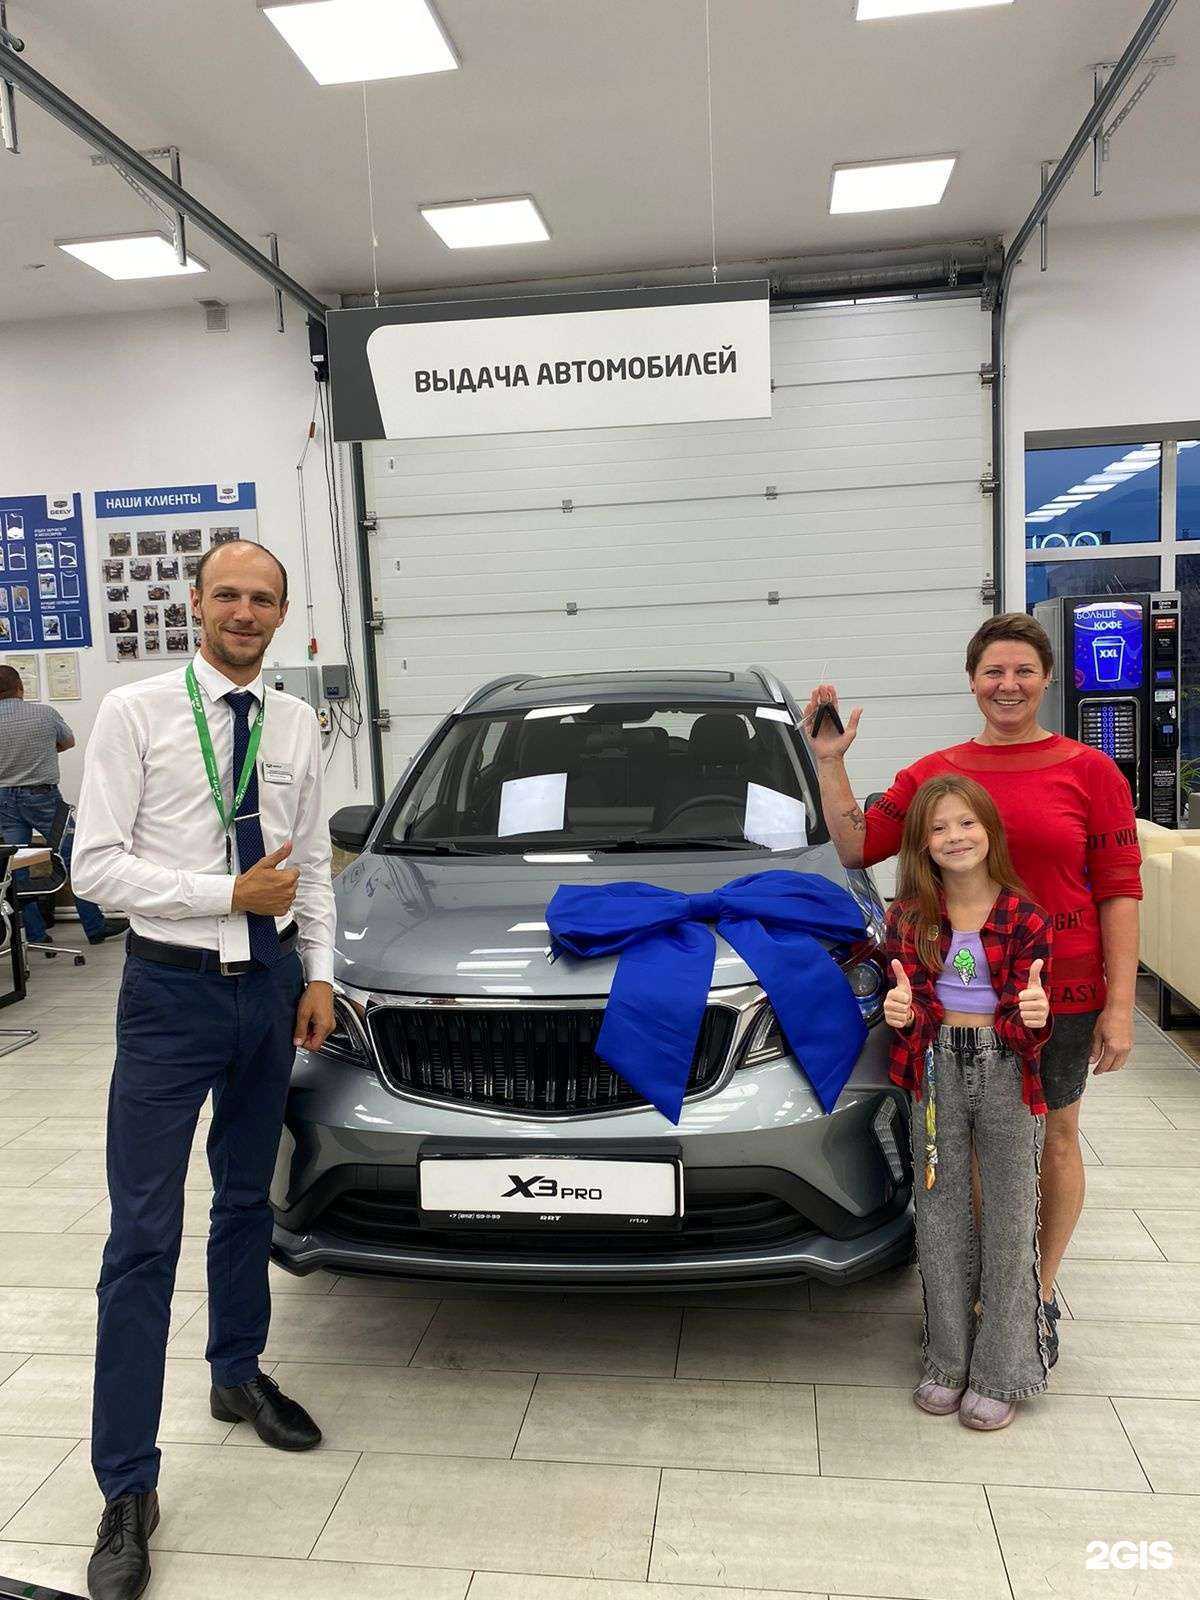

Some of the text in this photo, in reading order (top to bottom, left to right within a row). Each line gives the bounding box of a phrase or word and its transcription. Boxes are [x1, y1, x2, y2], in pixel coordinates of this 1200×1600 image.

[414, 344, 738, 394] ВЫДАЧА АВТОМОБИЛЕЙ
[106, 493, 201, 510] НАШИ КЛИЕНТЫ
[1076, 608, 1117, 619] БОЛЬШЕ
[1093, 620, 1123, 631] КОФЕ
[1099, 649, 1119, 659] XXL
[501, 1174, 603, 1200] X3 PRO
